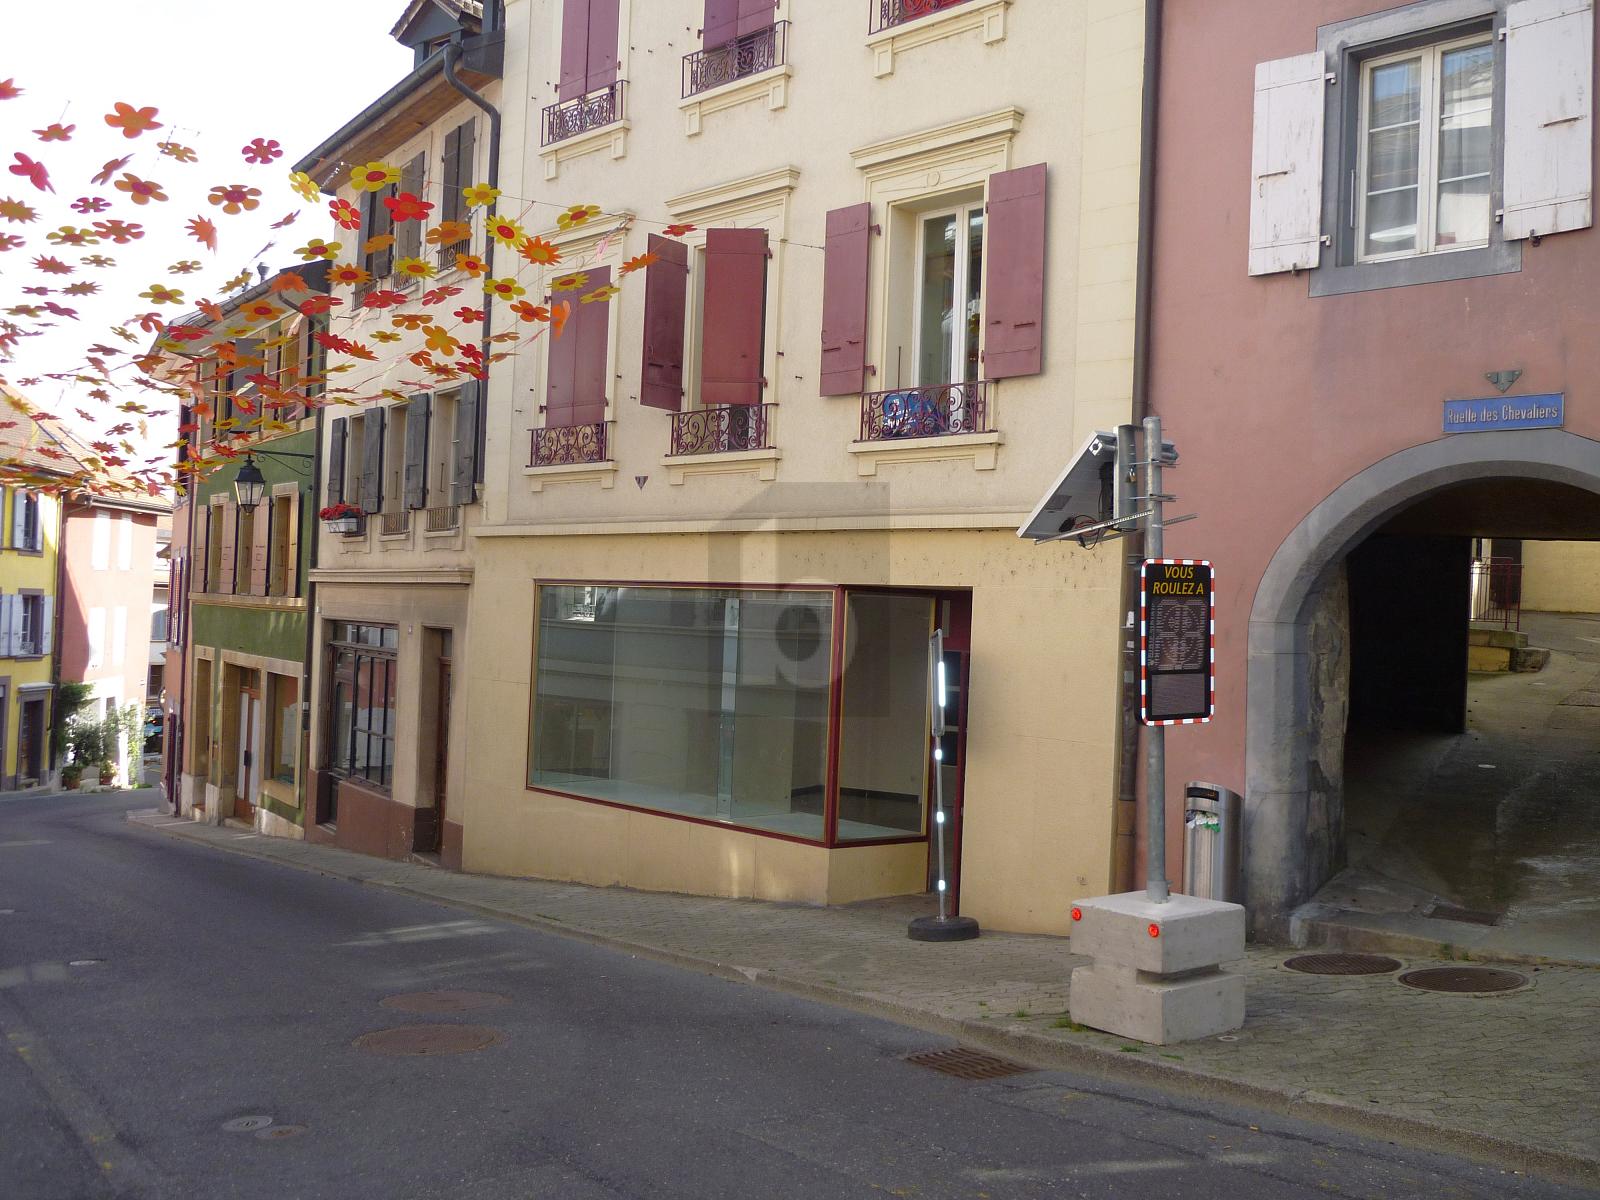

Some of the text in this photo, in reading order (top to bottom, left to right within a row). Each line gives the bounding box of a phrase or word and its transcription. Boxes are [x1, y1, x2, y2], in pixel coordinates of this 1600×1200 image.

[1447, 403, 1558, 424] Ruelle des Chevaliers
[1164, 566, 1194, 579] VOUS
[1152, 582, 1204, 595] ROULEZ A
